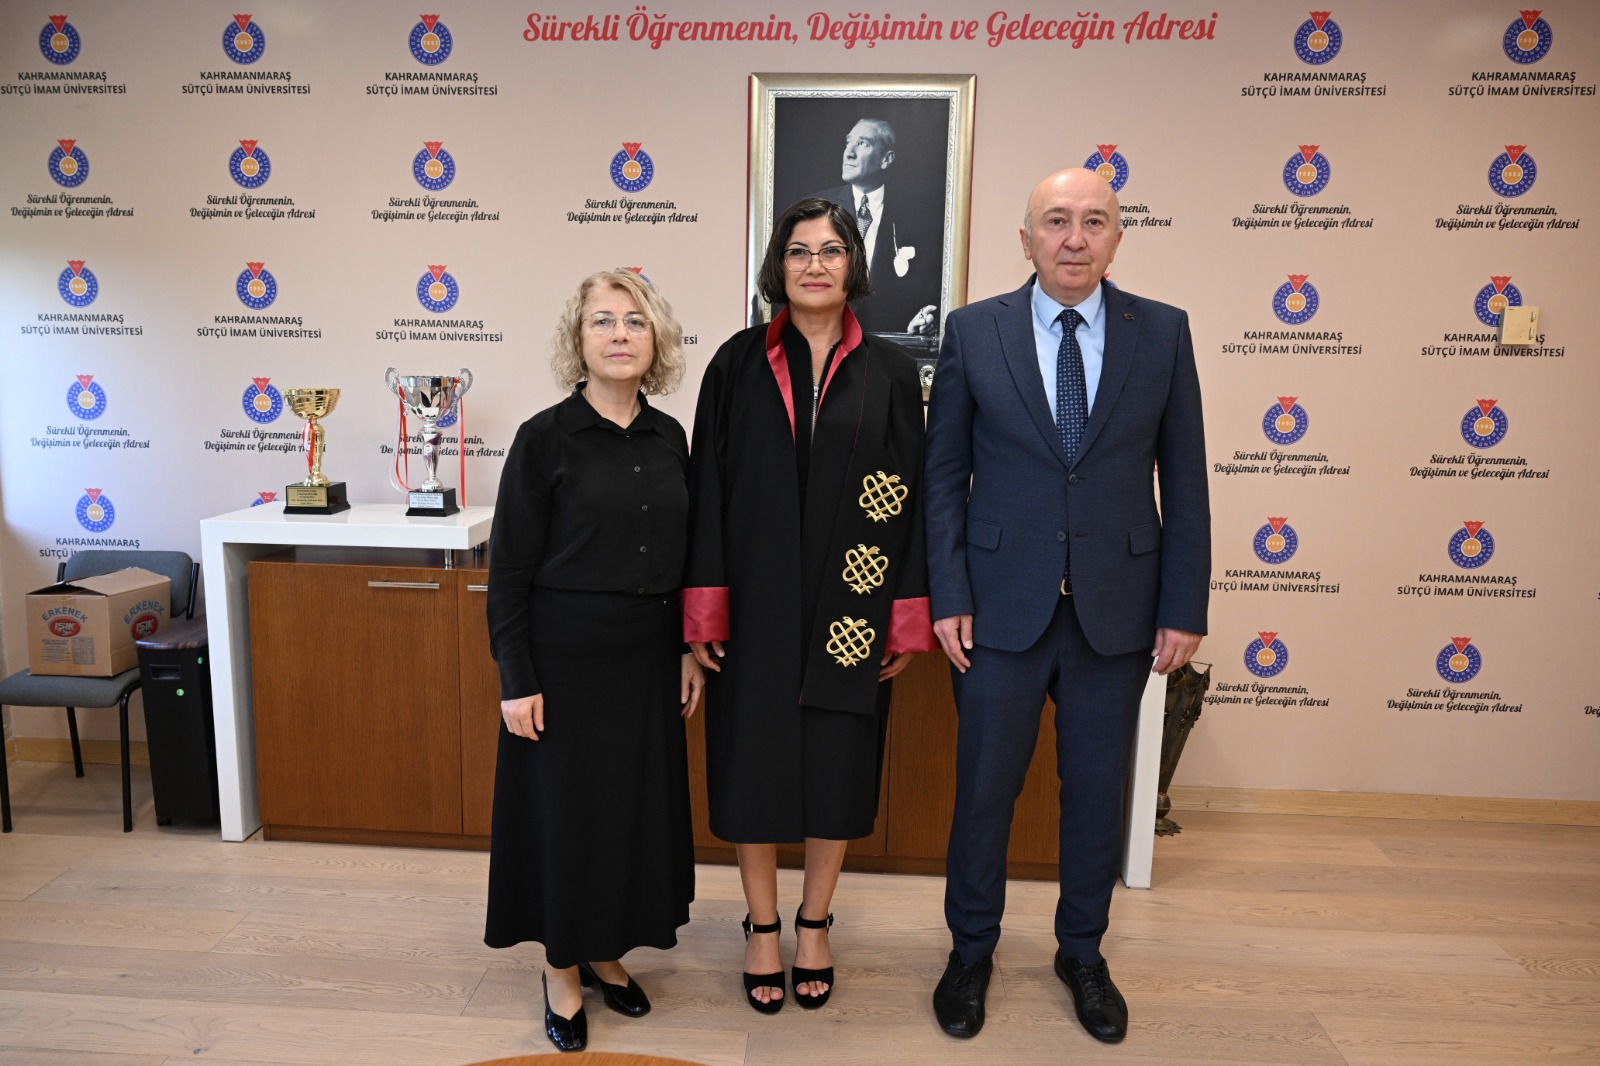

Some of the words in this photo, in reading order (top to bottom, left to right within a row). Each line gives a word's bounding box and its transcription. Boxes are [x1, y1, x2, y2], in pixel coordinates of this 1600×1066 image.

[524, 12, 620, 42] Sürekli
[626, 6, 798, 50] Öğrenmenin,
[807, 12, 942, 49] Değişimin
[950, 20, 979, 40] ve
[986, 11, 1114, 49] Geleceğin
[1123, 12, 1218, 44] Adresi
[18, 72, 107, 82] KAHRAMANMARAŞ
[200, 72, 291, 82] KAHRAMANMARAŞ
[386, 72, 478, 83] KAHRAMANMARAŞ
[1264, 72, 1366, 84] KAHRAMANMARAŞ
[1472, 72, 1576, 83] KAHRAMANMARAŞ
[1, 84, 31, 96] SÜTÇÜ
[34, 84, 60, 94] İMAM
[64, 84, 126, 94] ÜNİVERSİTESİ
[182, 84, 213, 96] SÜTÇÜ
[216, 84, 243, 94] İMAM
[246, 84, 310, 94] ÜNİVERSİTESİ
[366, 84, 398, 97] SÜTÇÜ
[401, 84, 429, 95] İMAM
[432, 84, 497, 95] ÜNİVERSİTESİ
[1242, 86, 1276, 99] SÜTÇÜ
[1280, 85, 1310, 96] İMAM
[1314, 85, 1386, 96] ÜNİVERSİTESİ
[1448, 85, 1484, 98] SÜTÇÜ
[1488, 85, 1519, 96] İMAM
[1522, 84, 1596, 96] ÜNİVERSİTESİ
[27, 194, 57, 204] Sürekli
[59, 192, 113, 206] Öğrenmenin,
[206, 195, 238, 204] Sürekli
[239, 193, 294, 207] Öğrenmenin,
[389, 197, 420, 206] Sürekli
[422, 196, 478, 210] Öğrenmenin,
[585, 199, 617, 208] Sürekli
[619, 197, 676, 211] Öğrenmenin,
[11, 207, 52, 219] Değişimin
[65, 207, 104, 219] Geleceğin
[106, 207, 134, 217] Adresi
[190, 208, 232, 220] Değişimin
[245, 208, 284, 220] Geleceğin
[287, 208, 315, 219] Adresi
[1253, 204, 1288, 214] Sürekli
[1290, 202, 1351, 217] Öğrenmenin,
[1456, 204, 1493, 214] Sürekli
[1494, 202, 1557, 218] Öğrenmenin,
[371, 210, 414, 222] Değişimin
[428, 210, 468, 223] Geleceğin
[470, 211, 500, 222] Adresi
[567, 212, 611, 224] Değişimin
[625, 212, 665, 224] Geleceğin
[668, 212, 698, 223] Adresi
[1140, 217, 1172, 227] Adresi
[1232, 217, 1279, 230] Değişimin
[1294, 217, 1338, 230] Geleceğin
[1341, 218, 1374, 228] Adresi
[1435, 218, 1483, 231] Değişimin
[1498, 218, 1544, 231] Geleceğin
[1546, 218, 1580, 230] Adresi
[38, 314, 124, 324] KAHRAMANMARAŞ
[215, 316, 302, 327] KAHRAMANMARAŞ
[394, 319, 484, 330] KAHRAMANMARAŞ
[21, 325, 50, 336] SÜTÇÜ
[53, 325, 79, 334] İMAM
[82, 325, 142, 335] ÜNİVERSİTESİ
[197, 327, 227, 338] SÜTÇÜ
[230, 327, 256, 337] İMAM
[260, 328, 321, 338] ÜNİVERSİTESİ
[376, 330, 406, 342] SÜTÇÜ
[410, 330, 436, 340] İMAM
[440, 331, 502, 342] ÜNİVERSİTESİ
[1244, 331, 1342, 343] KAHRAMANMARAŞ
[1222, 343, 1256, 356] SÜTÇÜ
[1260, 343, 1289, 353] İMAM
[1292, 344, 1362, 354] ÜNİVERSİTESİ
[1422, 346, 1456, 358] SÜTÇÜ
[1459, 346, 1490, 356] İMAM
[1493, 346, 1565, 357] ÜNİVERSİTESİ
[46, 426, 75, 435] Sürekli
[77, 424, 130, 438] Öğrenmenin,
[220, 429, 250, 439] Sürekli
[31, 438, 70, 449] Değişimin
[83, 438, 120, 450] Geleceğin
[122, 439, 150, 449] Adresi
[204, 441, 245, 452] Değişimin
[258, 442, 296, 453] Geleceğin
[477, 448, 504, 457] Adresi
[1233, 451, 1268, 460] Sürekli
[1270, 449, 1328, 463] Öğrenmenin,
[1430, 454, 1465, 464] Sürekli
[1467, 452, 1527, 467] Öğrenmenin,
[1214, 463, 1259, 475] Değişimin
[1274, 464, 1316, 477] Geleceğin
[1319, 465, 1350, 476] Adresi
[1410, 467, 1456, 479] Değişimin
[1471, 468, 1515, 480] Geleceğin
[1518, 469, 1550, 479] Adresi
[56, 538, 140, 549] KAHRAMANMARAŞ
[40, 548, 68, 559] SÜTÇÜ
[1226, 570, 1320, 582] KAHRAMANMARAŞ
[1419, 574, 1517, 586] KAHRAMANMARAŞ
[1211, 581, 1237, 592] ÜTÇÜ
[1240, 581, 1269, 591] İMAM
[1272, 582, 1340, 593] ÜNİVERSİTESİ
[1398, 585, 1431, 597] SÜTÇÜ
[1434, 586, 1464, 596] İMAM
[1467, 587, 1536, 598] ÜNİVERSİTESİ
[42, 607, 88, 623] ERKENEK
[124, 600, 164, 624] ERKENEK
[1216, 682, 1249, 692] Sürekli
[1251, 682, 1308, 695] Öğrenmenin,
[1407, 688, 1441, 698] Sürekli
[1442, 687, 1501, 701] Öğrenmenin,
[1203, 694, 1241, 705] eğişimin
[1255, 696, 1296, 708] Geleceğin
[1299, 697, 1330, 707] Adresi
[1387, 700, 1432, 711] Değişimin
[1446, 701, 1488, 714] Geleceğin
[1491, 703, 1522, 712] Adresi
